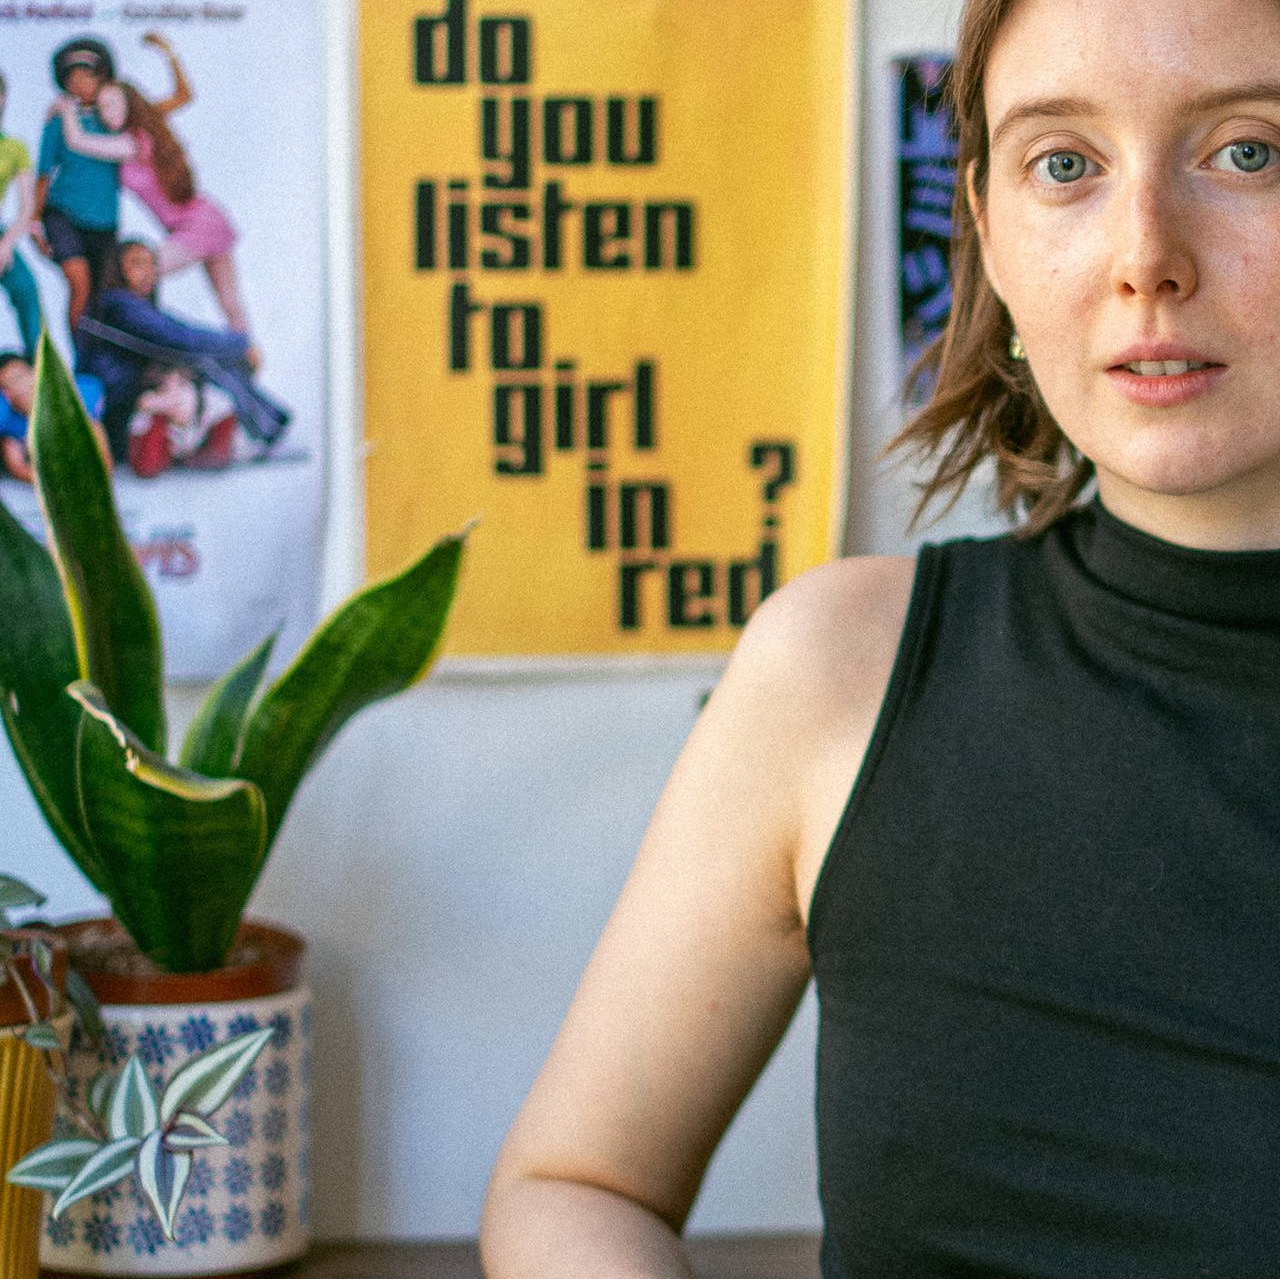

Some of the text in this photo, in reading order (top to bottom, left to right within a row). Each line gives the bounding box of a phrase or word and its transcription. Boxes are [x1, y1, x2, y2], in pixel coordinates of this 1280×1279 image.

[480, 95, 659, 190] you
[413, 181, 697, 270] listen
[449, 282, 545, 372] to
[492, 360, 659, 475] girl
[586, 458, 670, 550] in
[751, 440, 797, 527] ?
[619, 530, 780, 631] red
